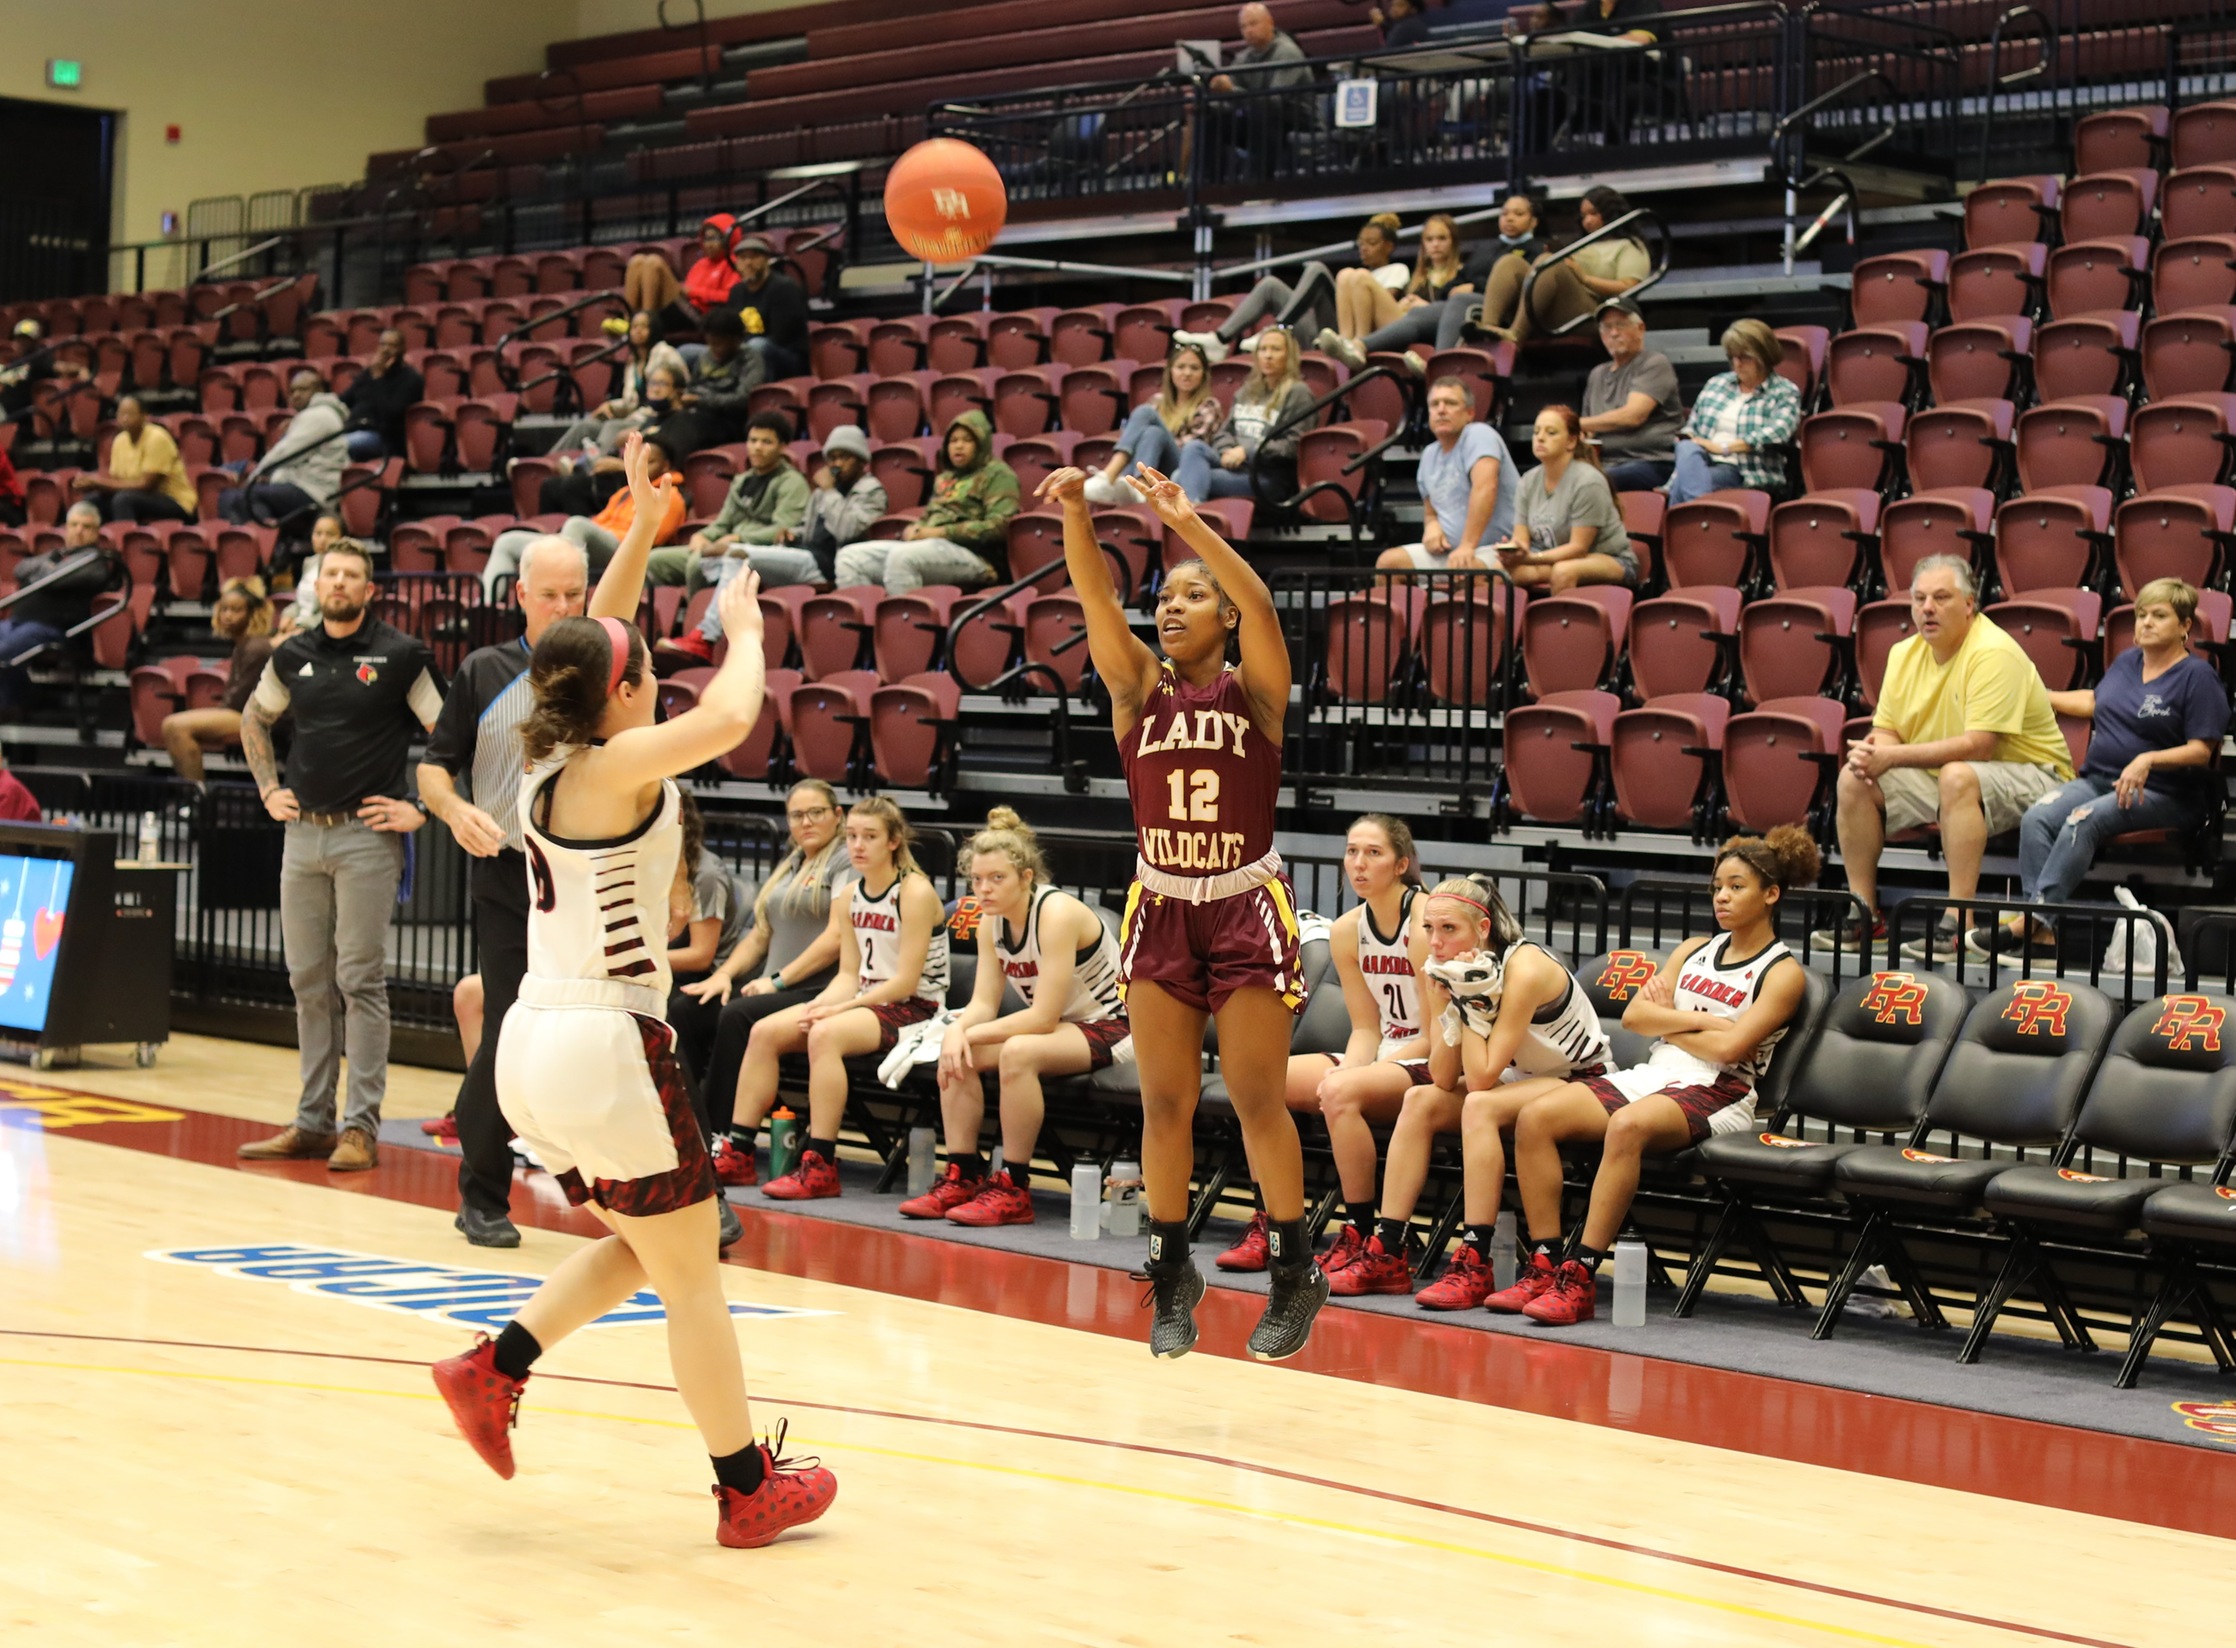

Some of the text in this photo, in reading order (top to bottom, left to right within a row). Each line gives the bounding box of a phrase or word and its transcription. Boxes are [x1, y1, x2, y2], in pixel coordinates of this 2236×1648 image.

[1136, 709, 1250, 759] LADY
[1166, 768, 1220, 822] 12
[1141, 826, 1245, 870] WILDCATS
[865, 937, 874, 971] 2
[1383, 983, 1408, 1020] 21
[1679, 972, 1748, 1009] GADSDEN
